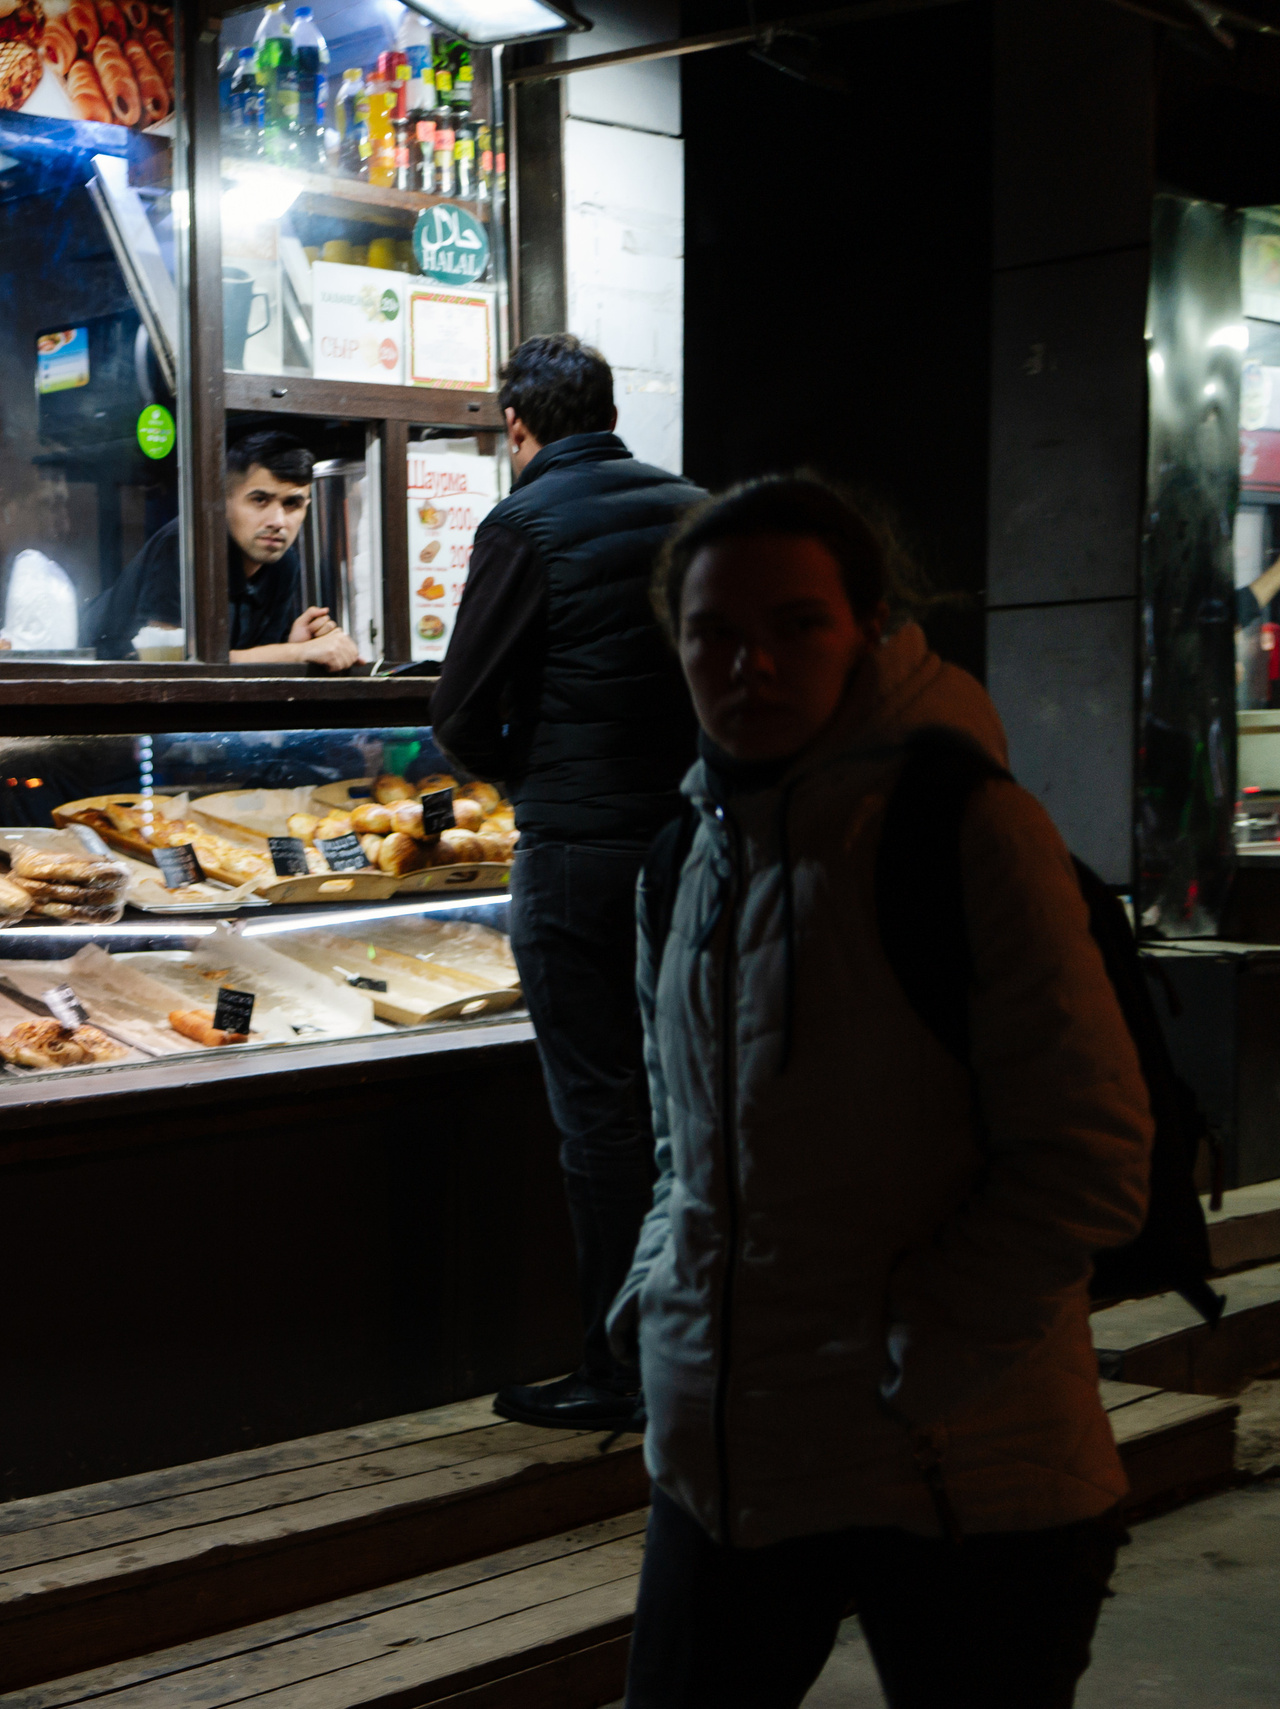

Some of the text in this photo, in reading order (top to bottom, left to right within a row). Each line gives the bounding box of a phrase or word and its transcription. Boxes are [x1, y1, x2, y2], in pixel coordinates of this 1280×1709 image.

[422, 250, 481, 276] HALAL
[321, 336, 360, 360] СЫР
[407, 459, 468, 498] Шаурма
